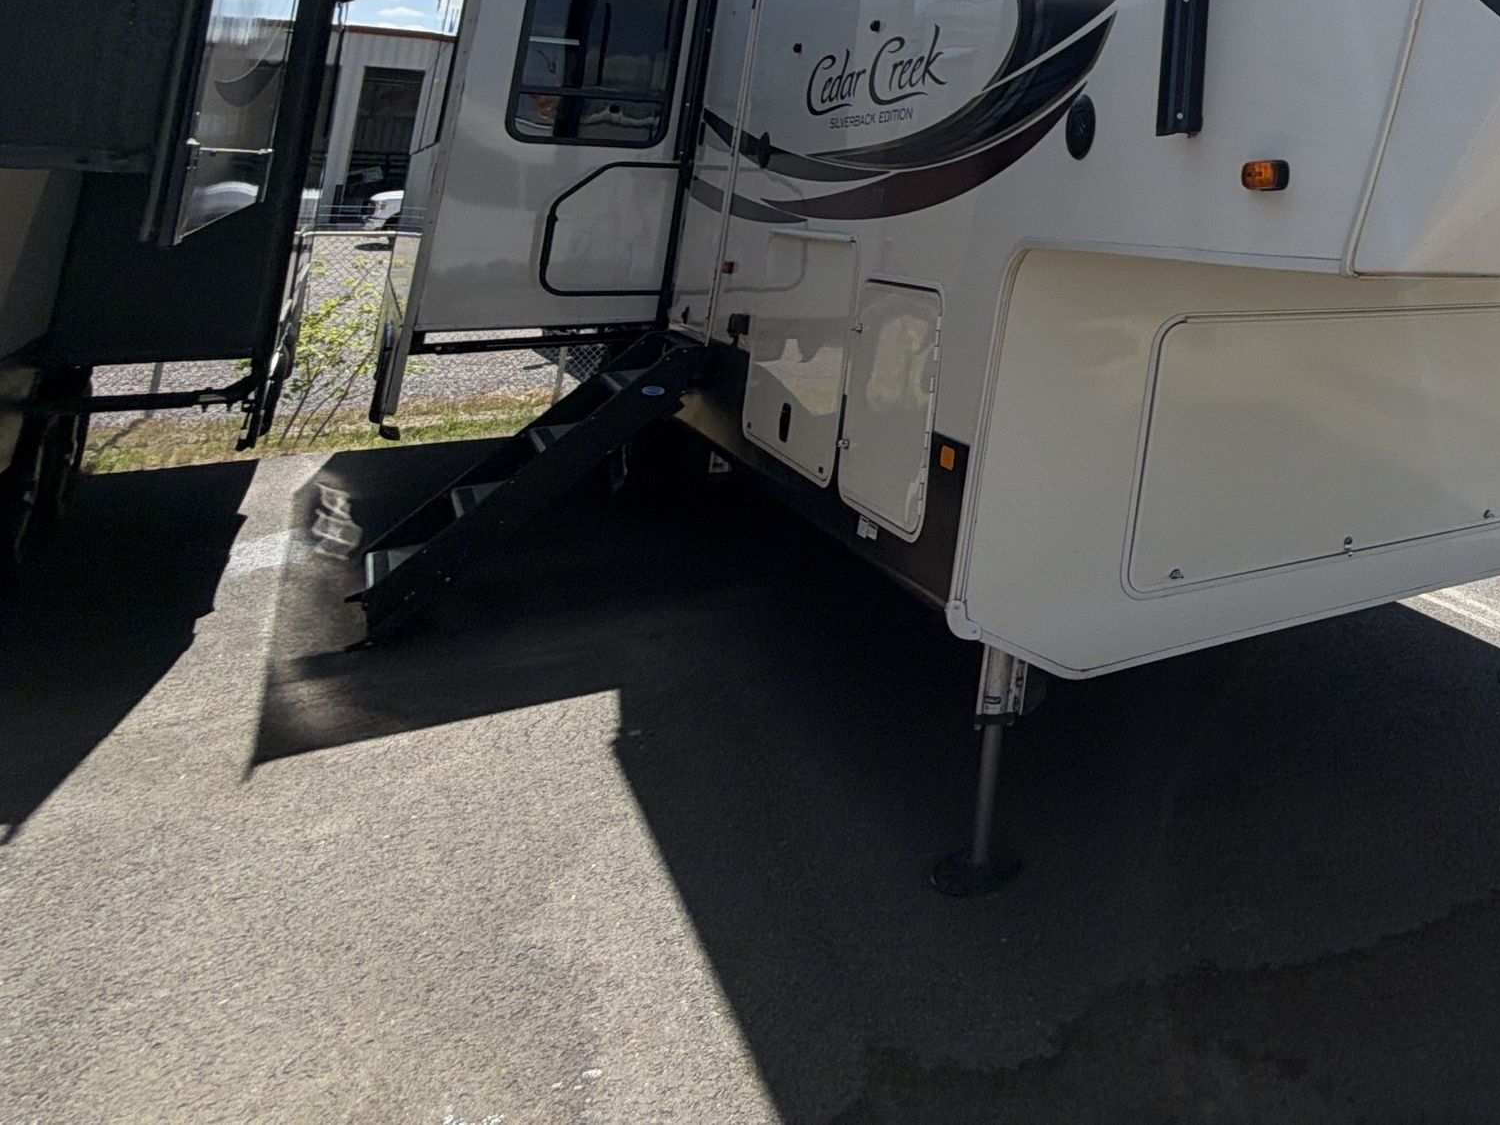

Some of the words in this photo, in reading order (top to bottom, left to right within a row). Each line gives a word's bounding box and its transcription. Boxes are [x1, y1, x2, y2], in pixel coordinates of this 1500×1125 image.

[806, 48, 867, 116] Cedar
[869, 23, 948, 106] Creek
[829, 113, 876, 129] SILVERBACK
[878, 107, 915, 124] EDITION
